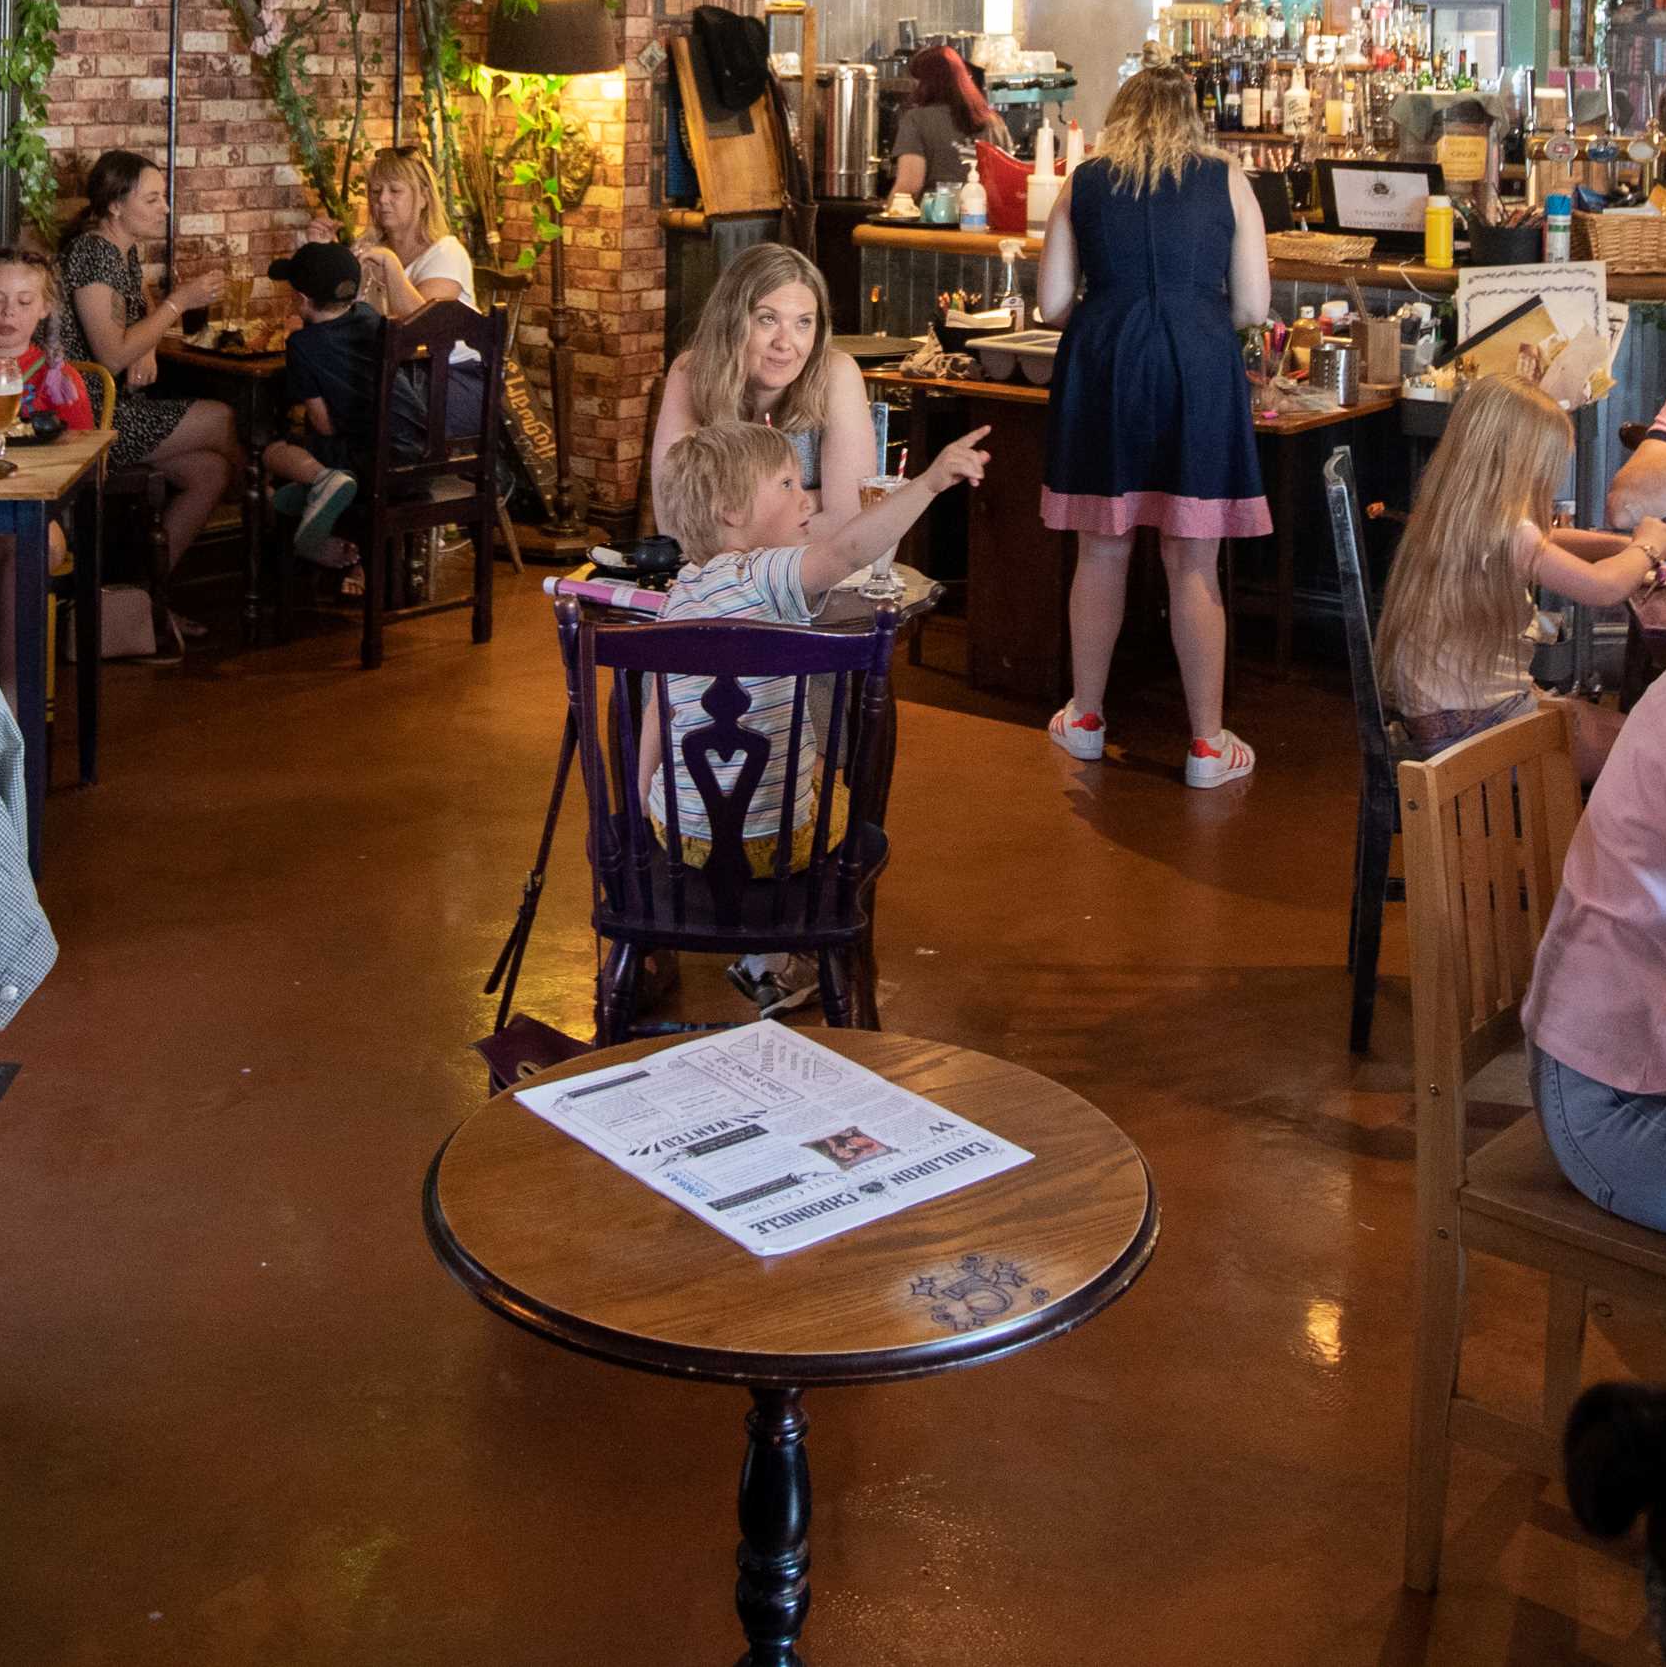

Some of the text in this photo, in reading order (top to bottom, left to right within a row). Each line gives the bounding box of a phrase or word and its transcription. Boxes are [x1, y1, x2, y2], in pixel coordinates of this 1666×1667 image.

[661, 1119, 735, 1149] WANTED
[889, 1141, 991, 1185] CAULDRON
[749, 1192, 860, 1235] CHRONICLE
